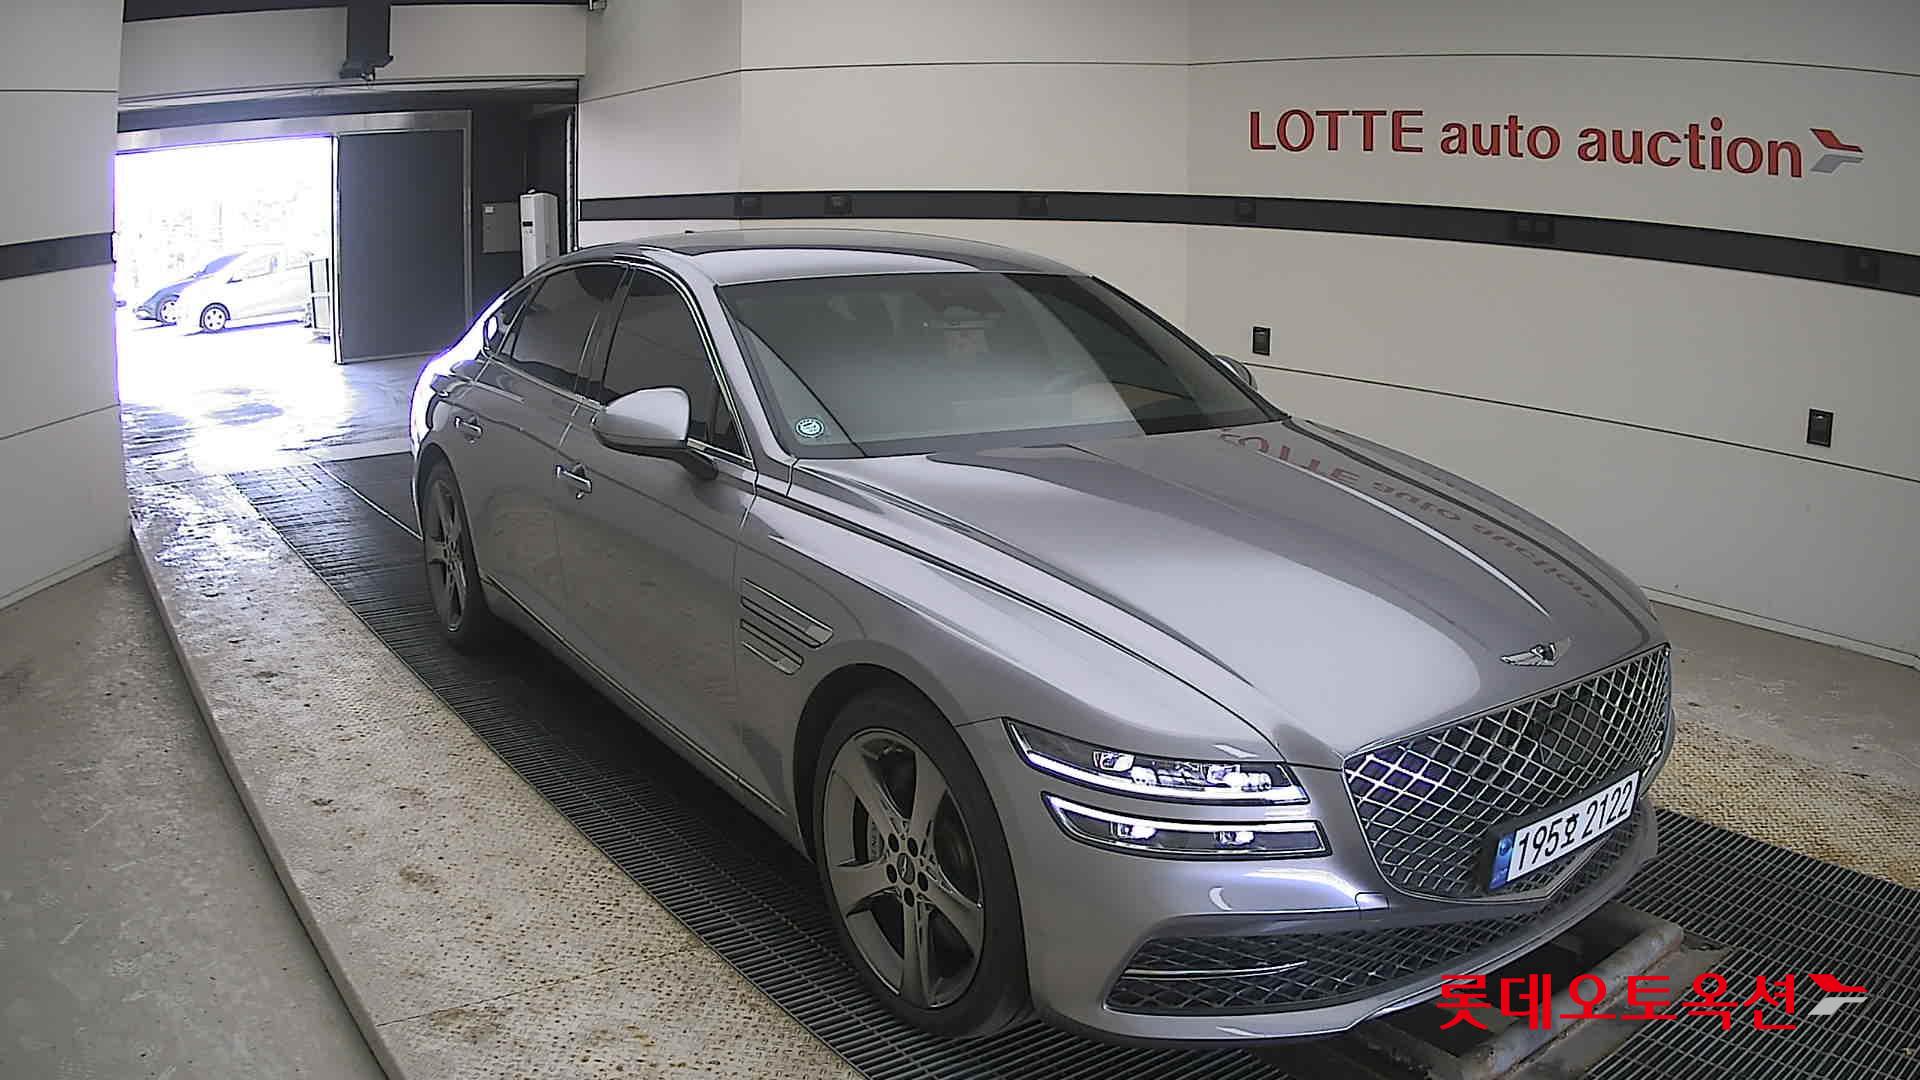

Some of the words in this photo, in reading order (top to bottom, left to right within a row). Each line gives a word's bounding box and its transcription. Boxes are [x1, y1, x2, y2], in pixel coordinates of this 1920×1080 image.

[1249, 110, 1424, 153] LOTTE
[1440, 115, 1561, 160] auto
[1577, 117, 1803, 178] auction
[1518, 813, 1580, 872] 195호
[1581, 780, 1633, 840] 2122
